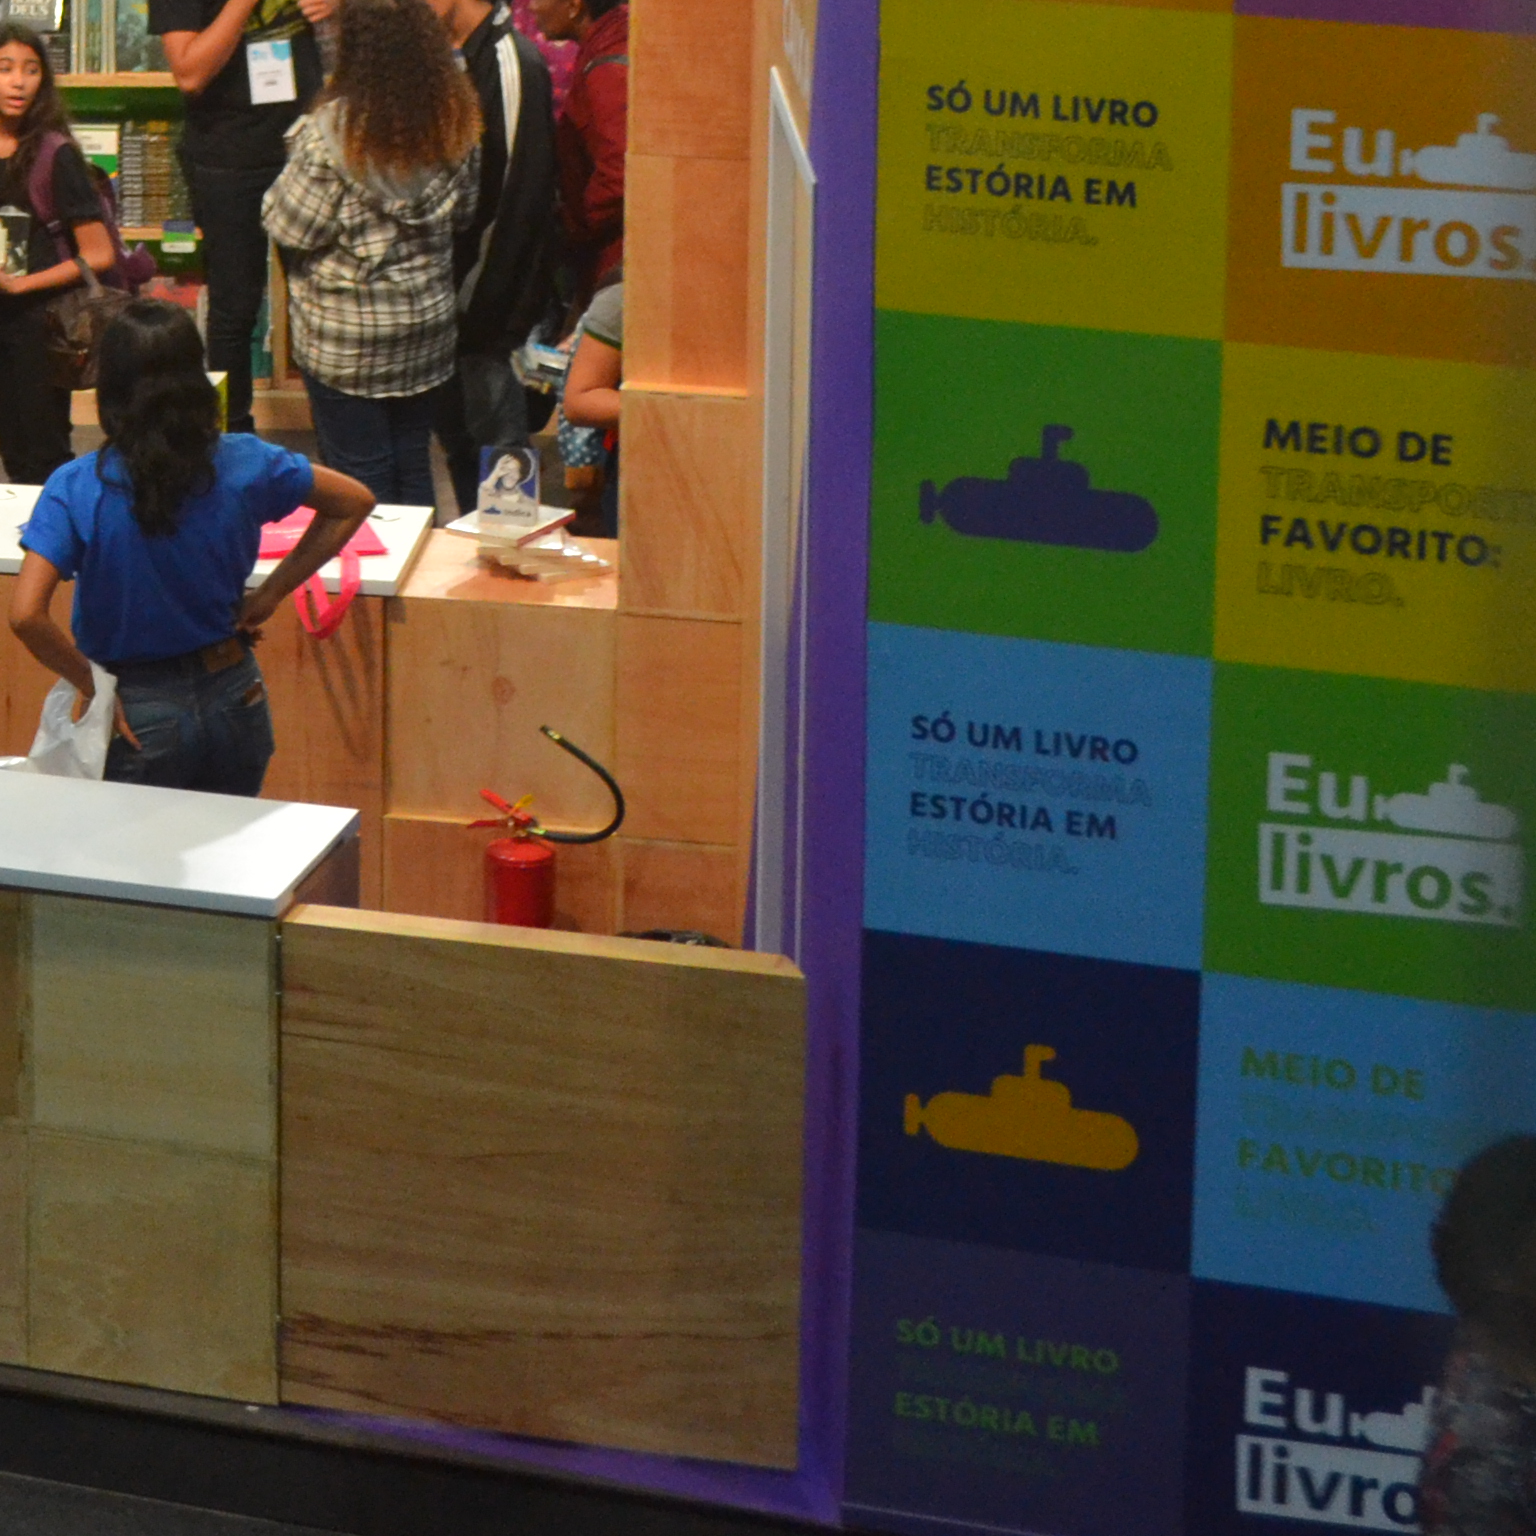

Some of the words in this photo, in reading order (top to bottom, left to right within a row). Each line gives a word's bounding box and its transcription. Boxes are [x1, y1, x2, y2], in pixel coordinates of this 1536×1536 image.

[926, 80, 973, 114] SÓ
[984, 89, 1041, 120] UM
[1053, 94, 1158, 130] LIVRO
[924, 123, 1174, 172] TRANSFORMA
[925, 164, 1072, 205] ESTÓRIA
[1084, 177, 1138, 209] EM
[1263, 418, 1382, 459] MEIO
[1397, 430, 1454, 466] DE
[1259, 514, 1502, 570] FAVORITO:
[911, 712, 957, 744] SÓ
[967, 720, 1022, 751] UM
[1034, 728, 1139, 766] LIVRO
[1266, 751, 1368, 823] Eu
[910, 790, 1054, 833] ESTÓRIA
[1065, 809, 1118, 842] EM
[1240, 1044, 1358, 1091] MEIO
[1370, 1063, 1426, 1103] DE
[897, 1314, 942, 1349] SÓ
[951, 1325, 1007, 1361] UM
[1017, 1336, 1121, 1375] LIVRO
[893, 1390, 1039, 1438] ESTÓRIA
[1046, 1414, 1101, 1447] EM
[1244, 1365, 1344, 1437] Eu
[1246, 1443, 1423, 1527] livro
